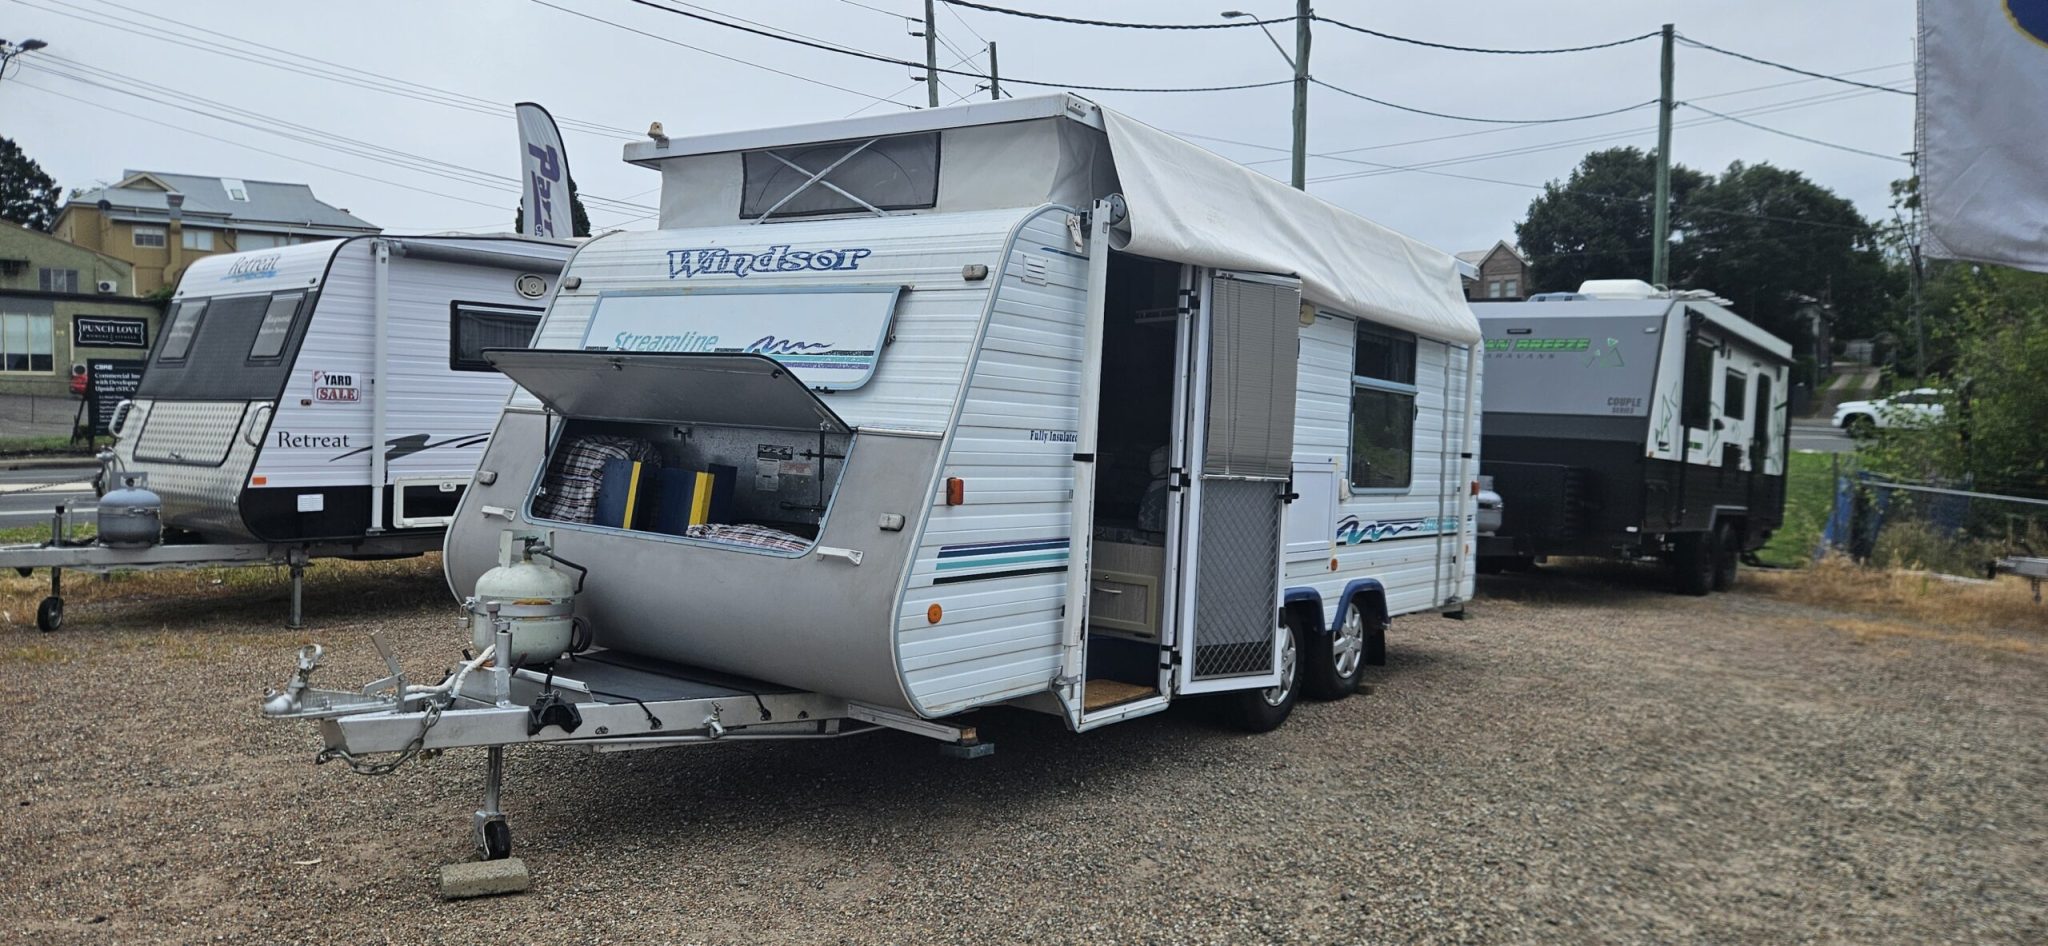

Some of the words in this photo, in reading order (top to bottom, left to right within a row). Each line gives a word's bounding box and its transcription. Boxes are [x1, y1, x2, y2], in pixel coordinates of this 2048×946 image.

[228, 254, 281, 275] Retreat
[666, 244, 872, 279] Windsor
[82, 324, 114, 333] PUNCH
[116, 326, 140, 334] LOVE
[614, 331, 720, 352] Streamline
[1514, 338, 1591, 352] BREEZE
[324, 375, 352, 386] YARD
[319, 388, 355, 400] SALE
[1607, 397, 1643, 408] COUPLE
[278, 431, 350, 447] Retreat
[1030, 430, 1048, 444] Fully
